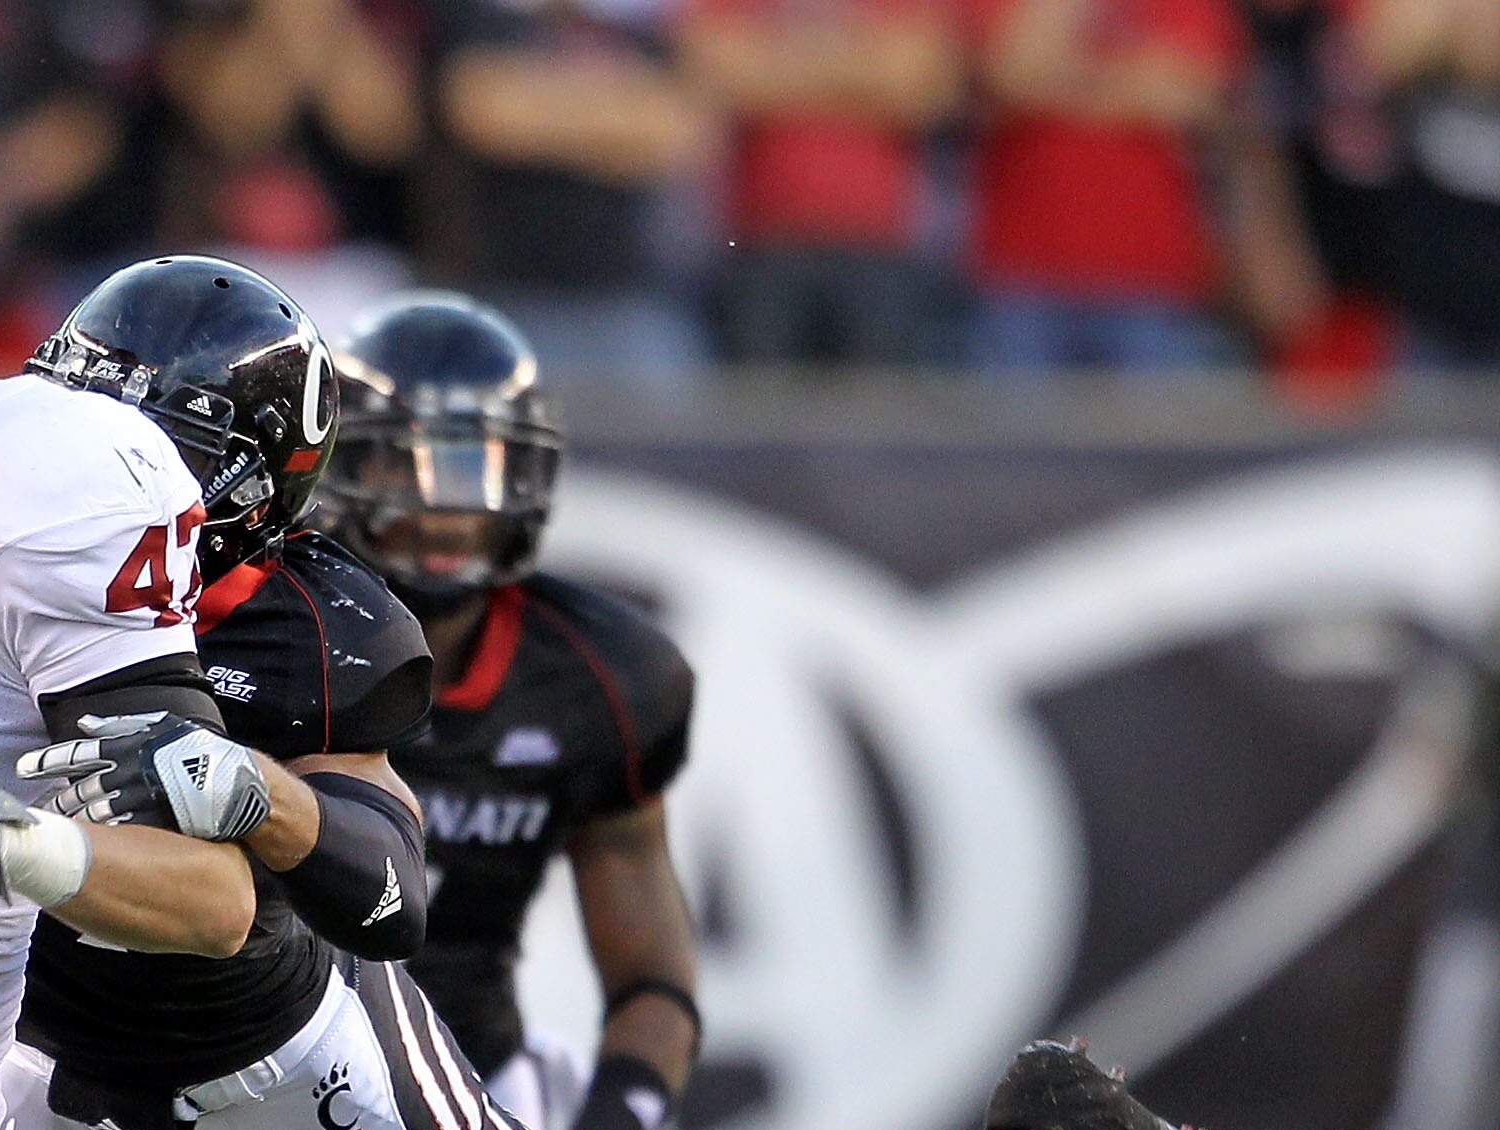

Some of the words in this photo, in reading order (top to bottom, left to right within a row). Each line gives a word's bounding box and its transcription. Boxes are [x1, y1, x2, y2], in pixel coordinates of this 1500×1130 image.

[96, 358, 122, 372] BIG
[91, 366, 125, 383] EAST
[186, 402, 213, 417] adidas
[206, 666, 250, 683] BIG
[196, 753, 210, 791] adidas
